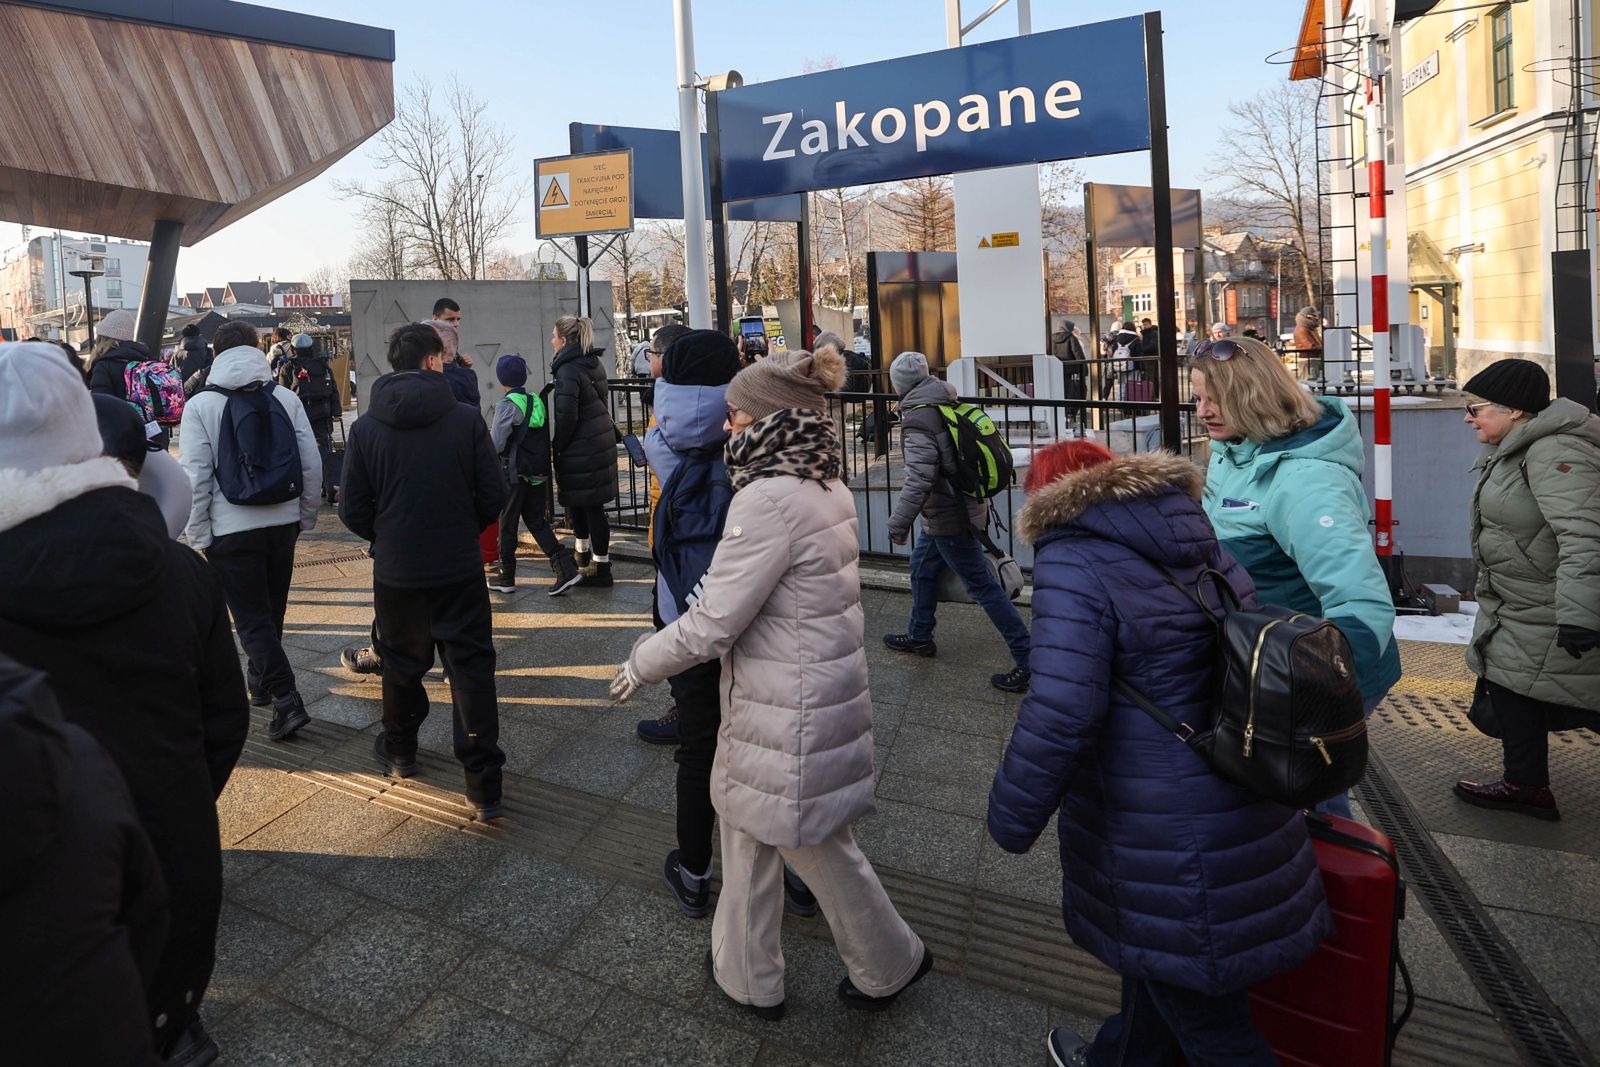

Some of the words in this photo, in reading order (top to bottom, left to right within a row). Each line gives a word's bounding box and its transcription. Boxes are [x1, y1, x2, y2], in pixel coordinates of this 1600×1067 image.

[762, 79, 1082, 161] Zakopane
[611, 173, 625, 181] POD
[608, 195, 628, 204] GROZI
[282, 294, 334, 306] MARKET
